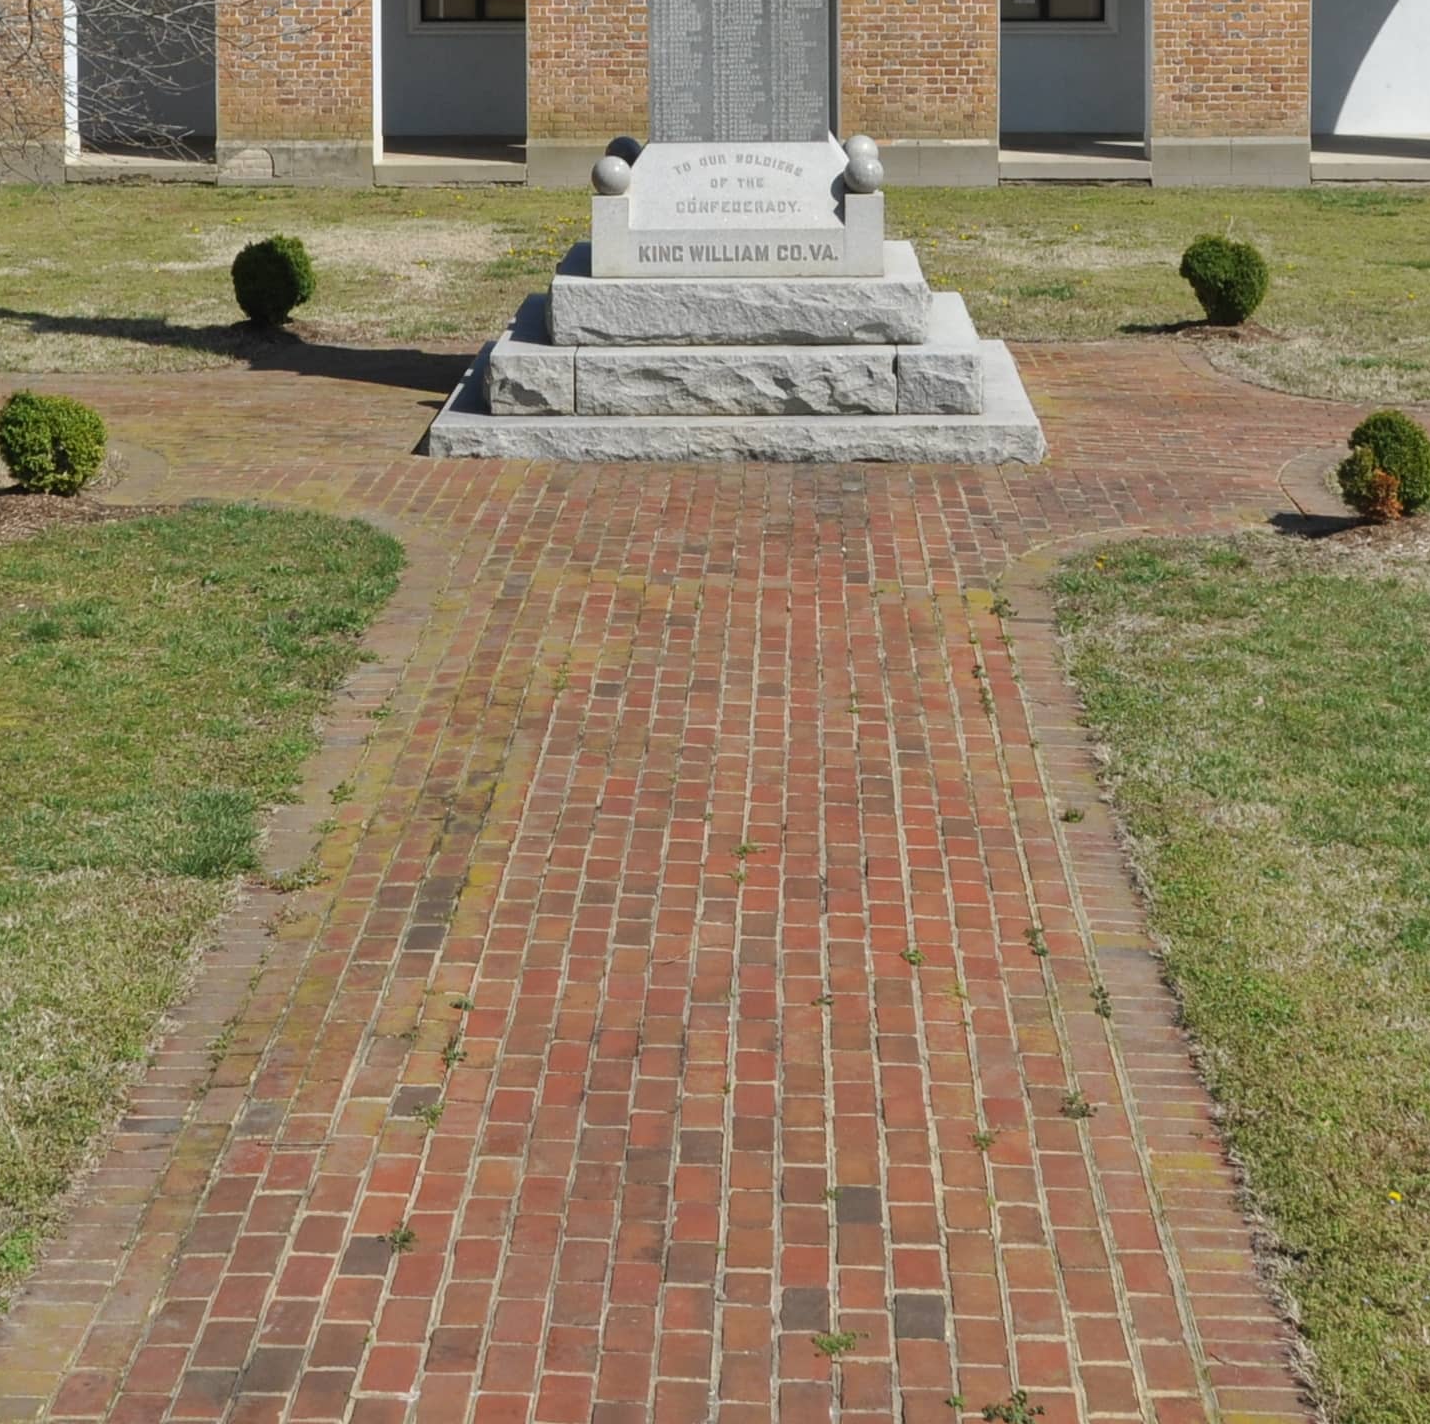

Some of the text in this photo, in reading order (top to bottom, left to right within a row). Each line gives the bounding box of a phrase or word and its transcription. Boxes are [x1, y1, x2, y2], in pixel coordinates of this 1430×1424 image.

[673, 154, 804, 177] TO OUR SOLDIERS
[710, 178, 764, 188] OF THE
[676, 200, 802, 213] CONFEDERACY.
[638, 244, 684, 263] KING
[689, 244, 770, 263] WILLIAM
